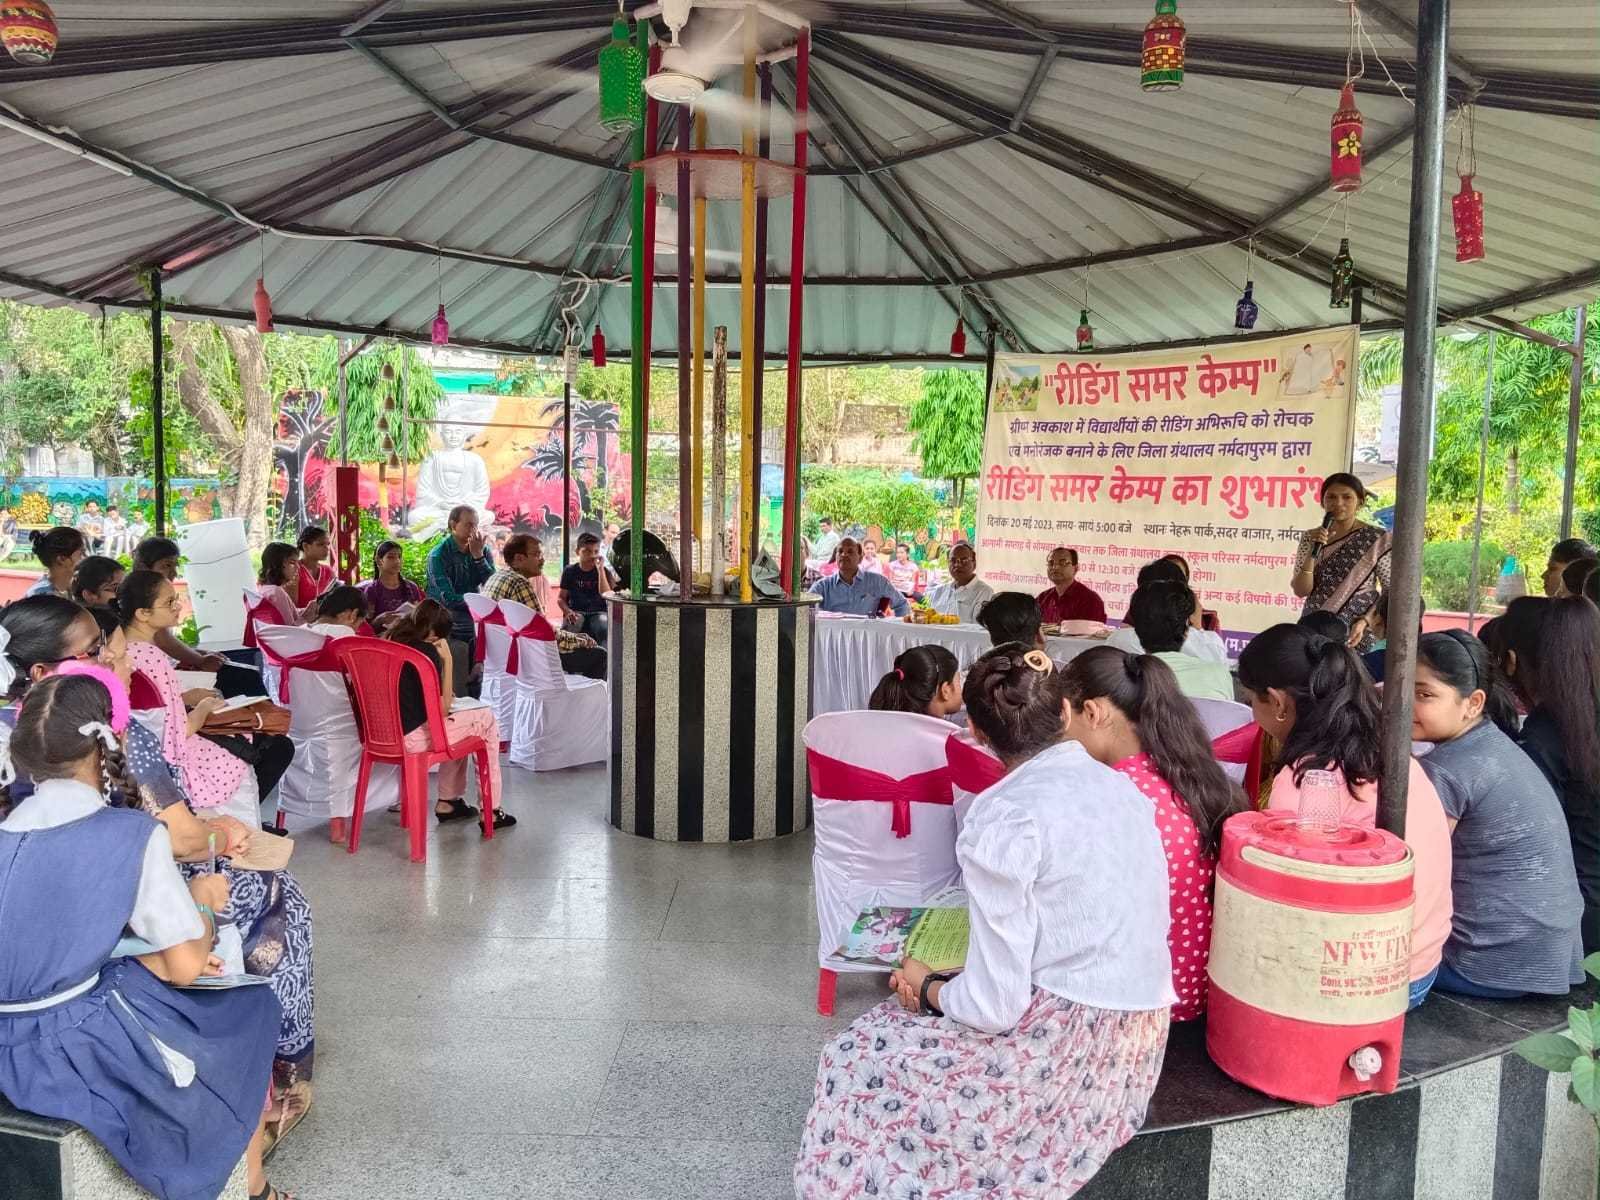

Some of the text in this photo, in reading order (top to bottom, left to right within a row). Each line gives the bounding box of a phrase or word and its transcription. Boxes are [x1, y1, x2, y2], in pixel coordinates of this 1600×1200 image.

[1044, 354, 1277, 405] "रीडिंग समर केम्प"
[1031, 420, 1074, 434] अवकाश
[1075, 417, 1087, 433] में
[1141, 415, 1158, 433] की
[1160, 415, 1193, 433] रीडिंग
[1250, 409, 1270, 428] को
[1273, 408, 1315, 428] रोचक
[1008, 437, 1312, 462] एवं मनोरंजक बनाने के लिए जिला ग्रंथालय नर्मदापुरम द्वारा
[986, 464, 1045, 502] रीडिंग
[1049, 474, 1104, 503] समर
[1109, 465, 1167, 505] केम्प
[1171, 475, 1213, 506] का
[1010, 518, 1021, 528] 20
[1096, 522, 1116, 534] 5:00
